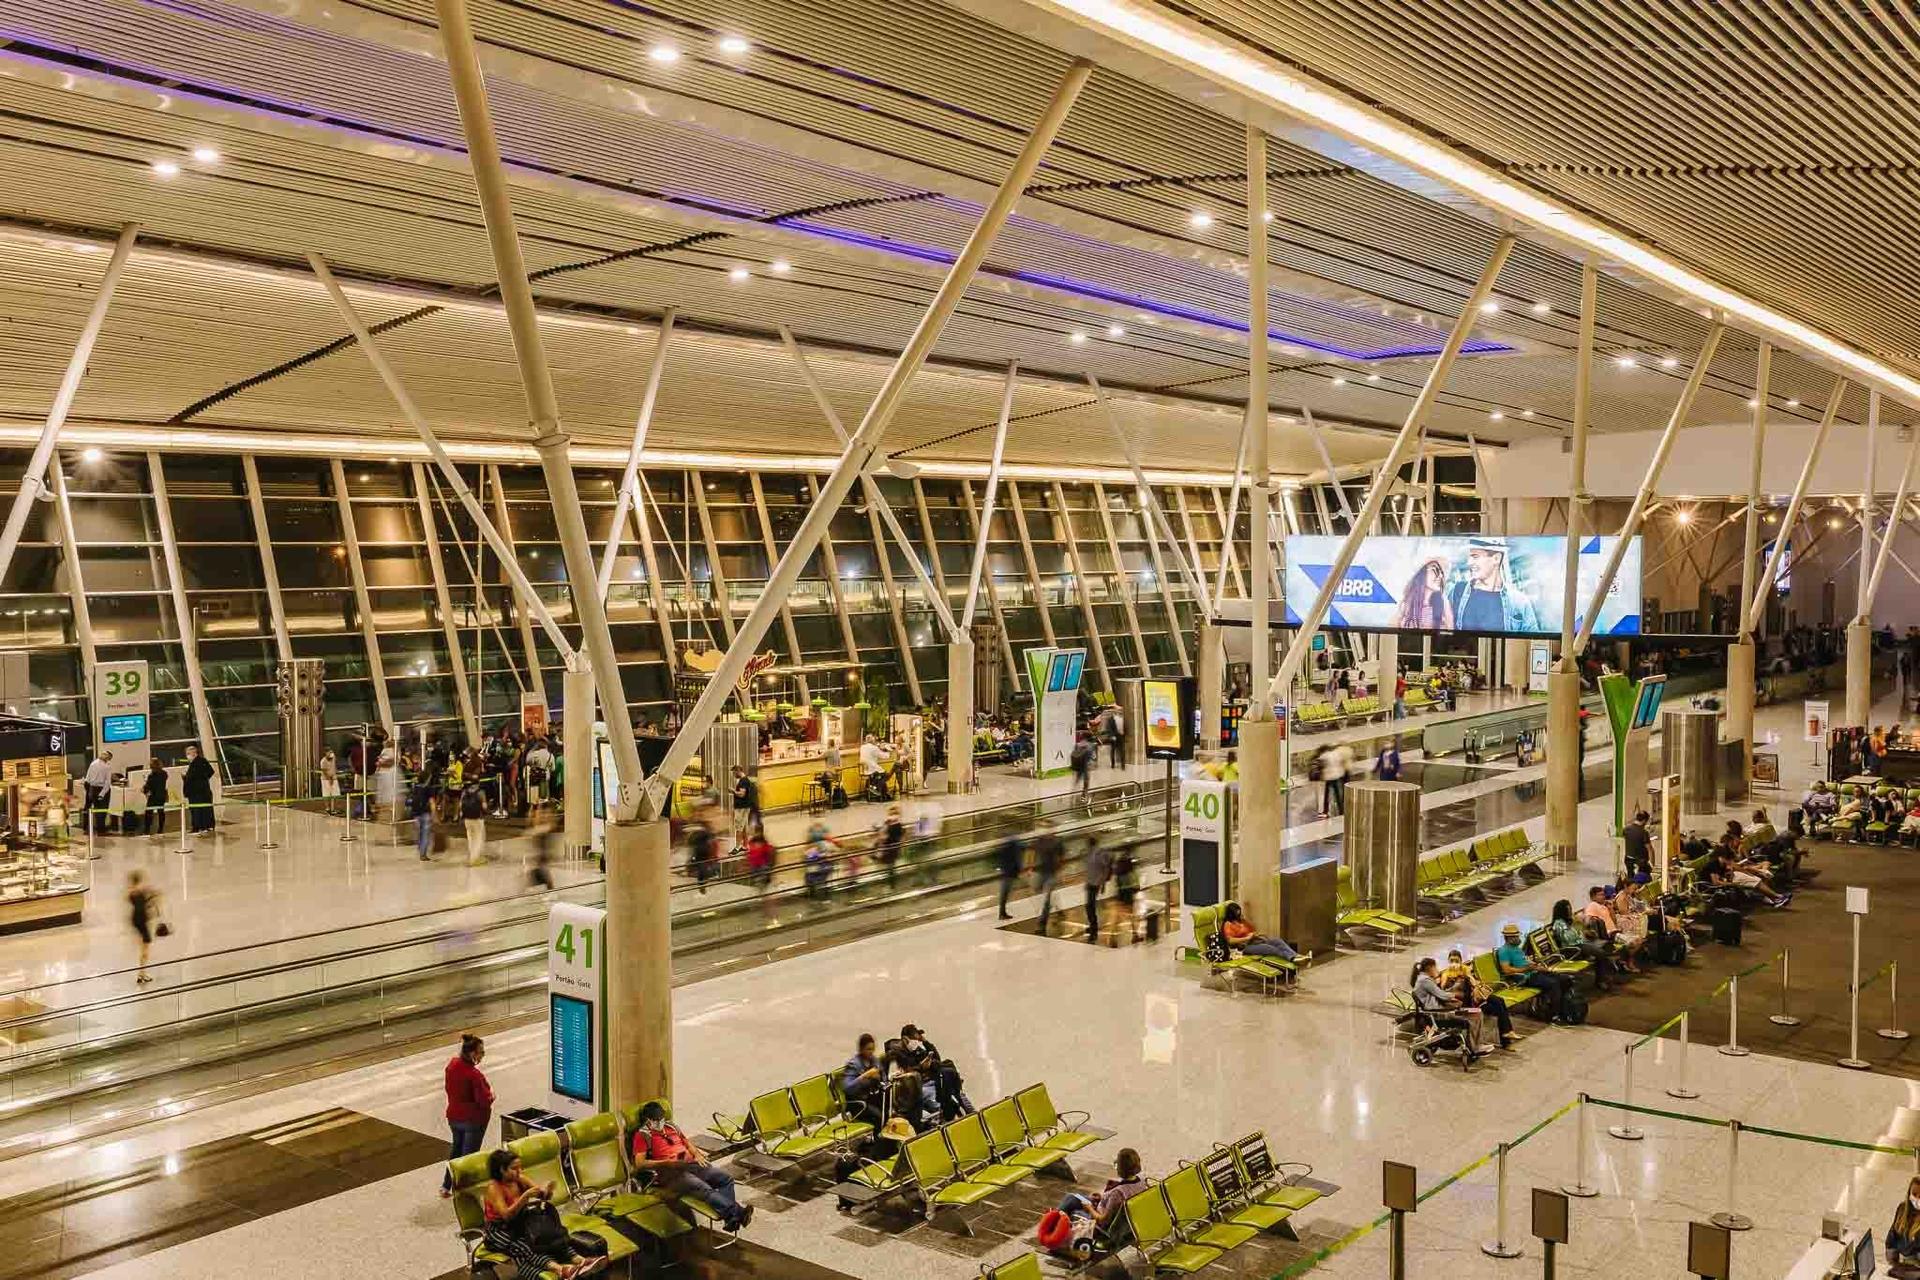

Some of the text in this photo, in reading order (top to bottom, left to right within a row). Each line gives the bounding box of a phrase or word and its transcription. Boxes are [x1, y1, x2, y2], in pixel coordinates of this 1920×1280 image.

[1342, 579, 1374, 596] BRB
[105, 671, 141, 695] 39
[1184, 792, 1220, 820] 40
[554, 923, 593, 969] 41
